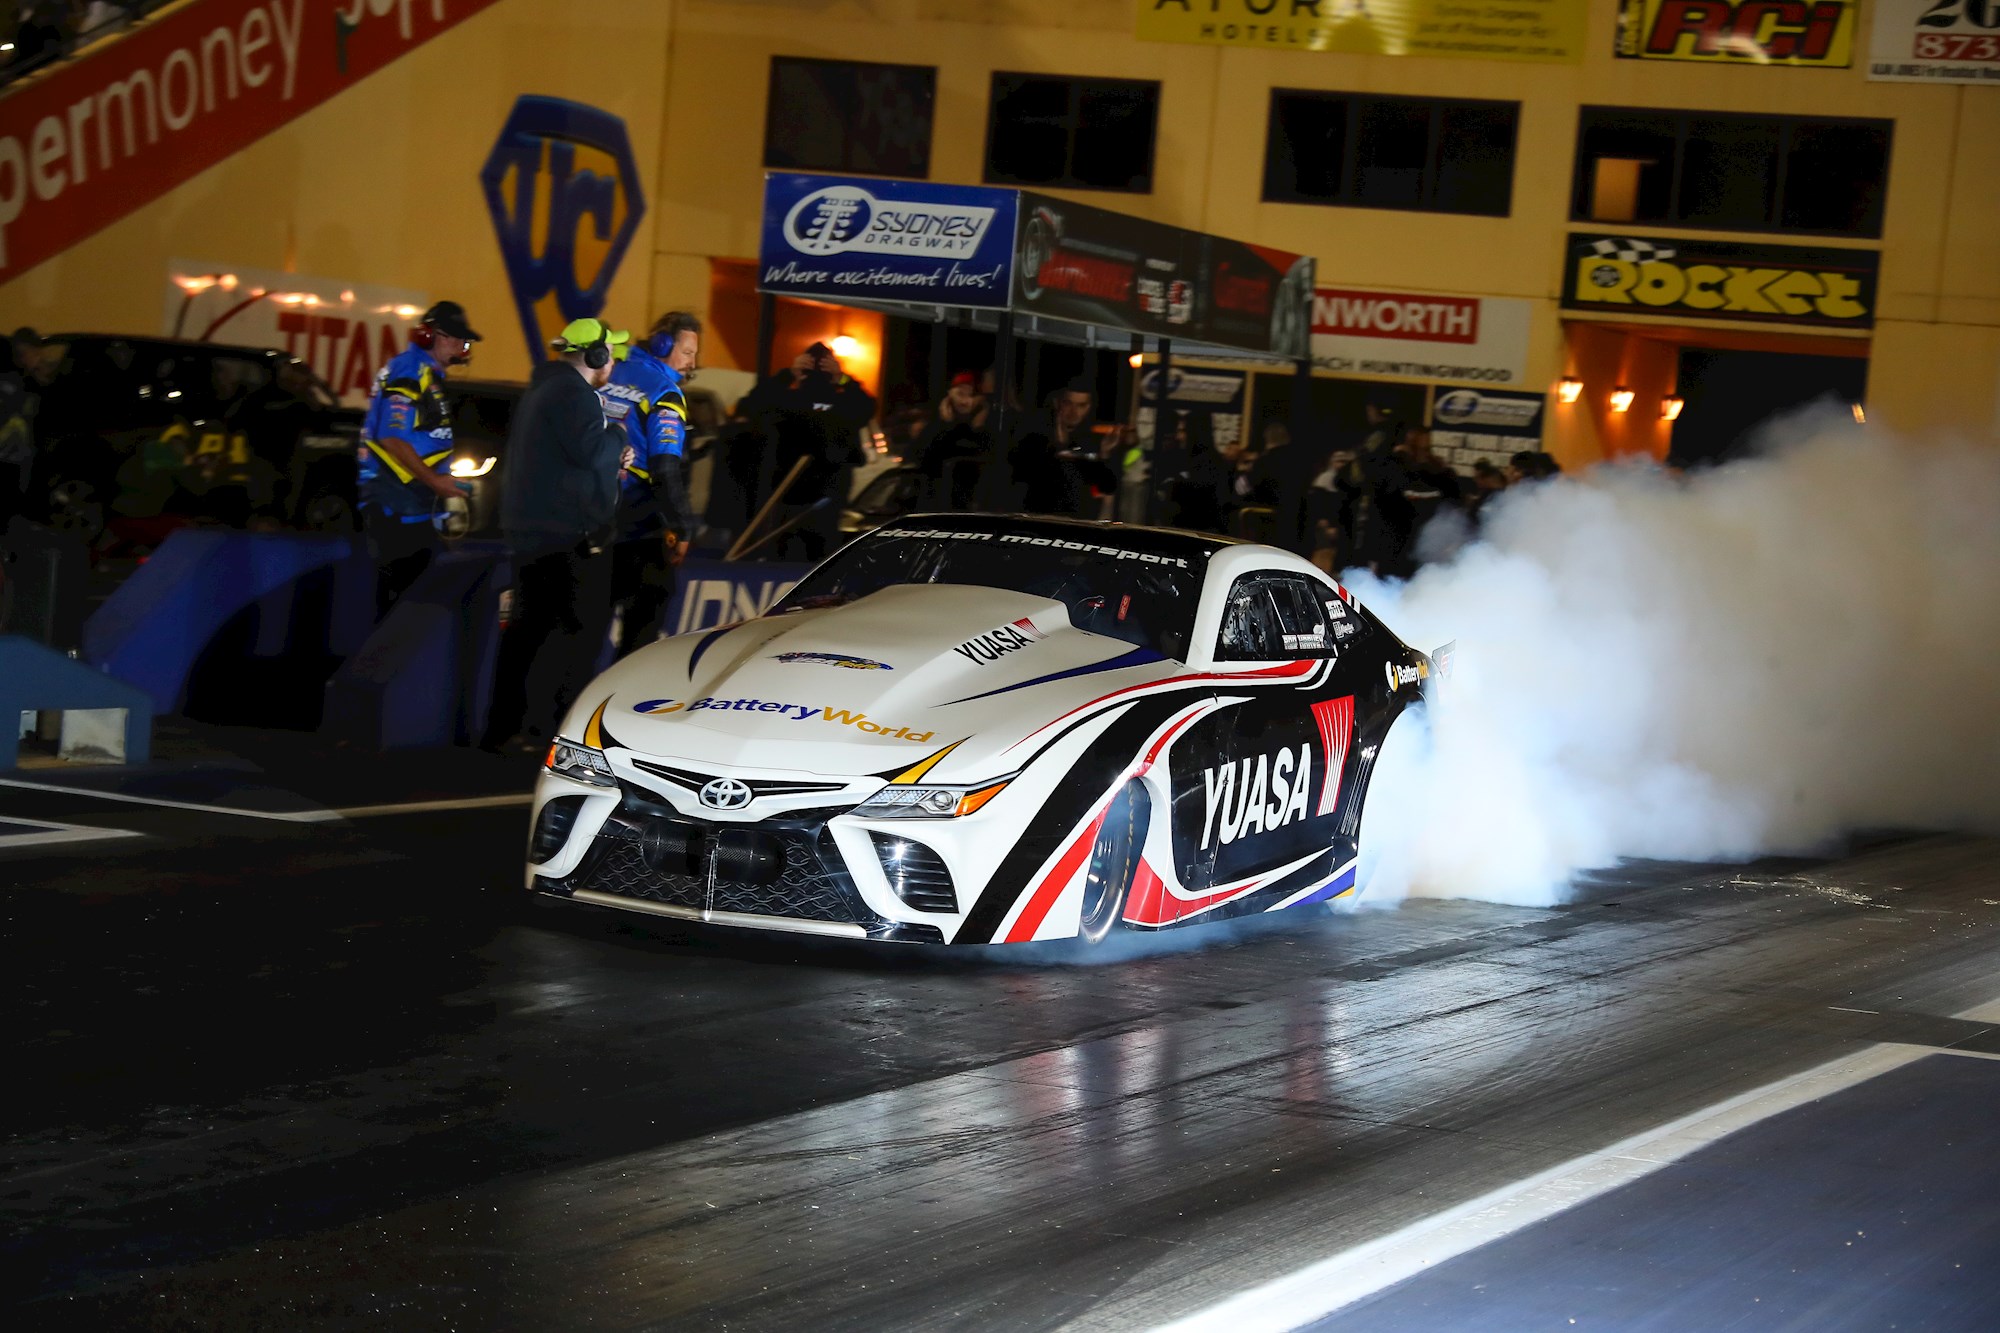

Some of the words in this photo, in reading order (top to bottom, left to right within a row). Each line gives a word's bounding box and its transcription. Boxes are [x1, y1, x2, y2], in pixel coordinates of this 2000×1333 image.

[865, 233, 970, 250] DRAGWAY
[872, 211, 983, 238] SYDNEY
[764, 262, 829, 284] Where
[833, 268, 940, 287] excitement
[943, 261, 1003, 289] lives!
[1312, 296, 1475, 337] NWORTH
[876, 528, 993, 542] dodson
[1000, 534, 1188, 569] motorsport
[953, 626, 1036, 666] YUASA
[1200, 743, 1312, 851] YUASA
